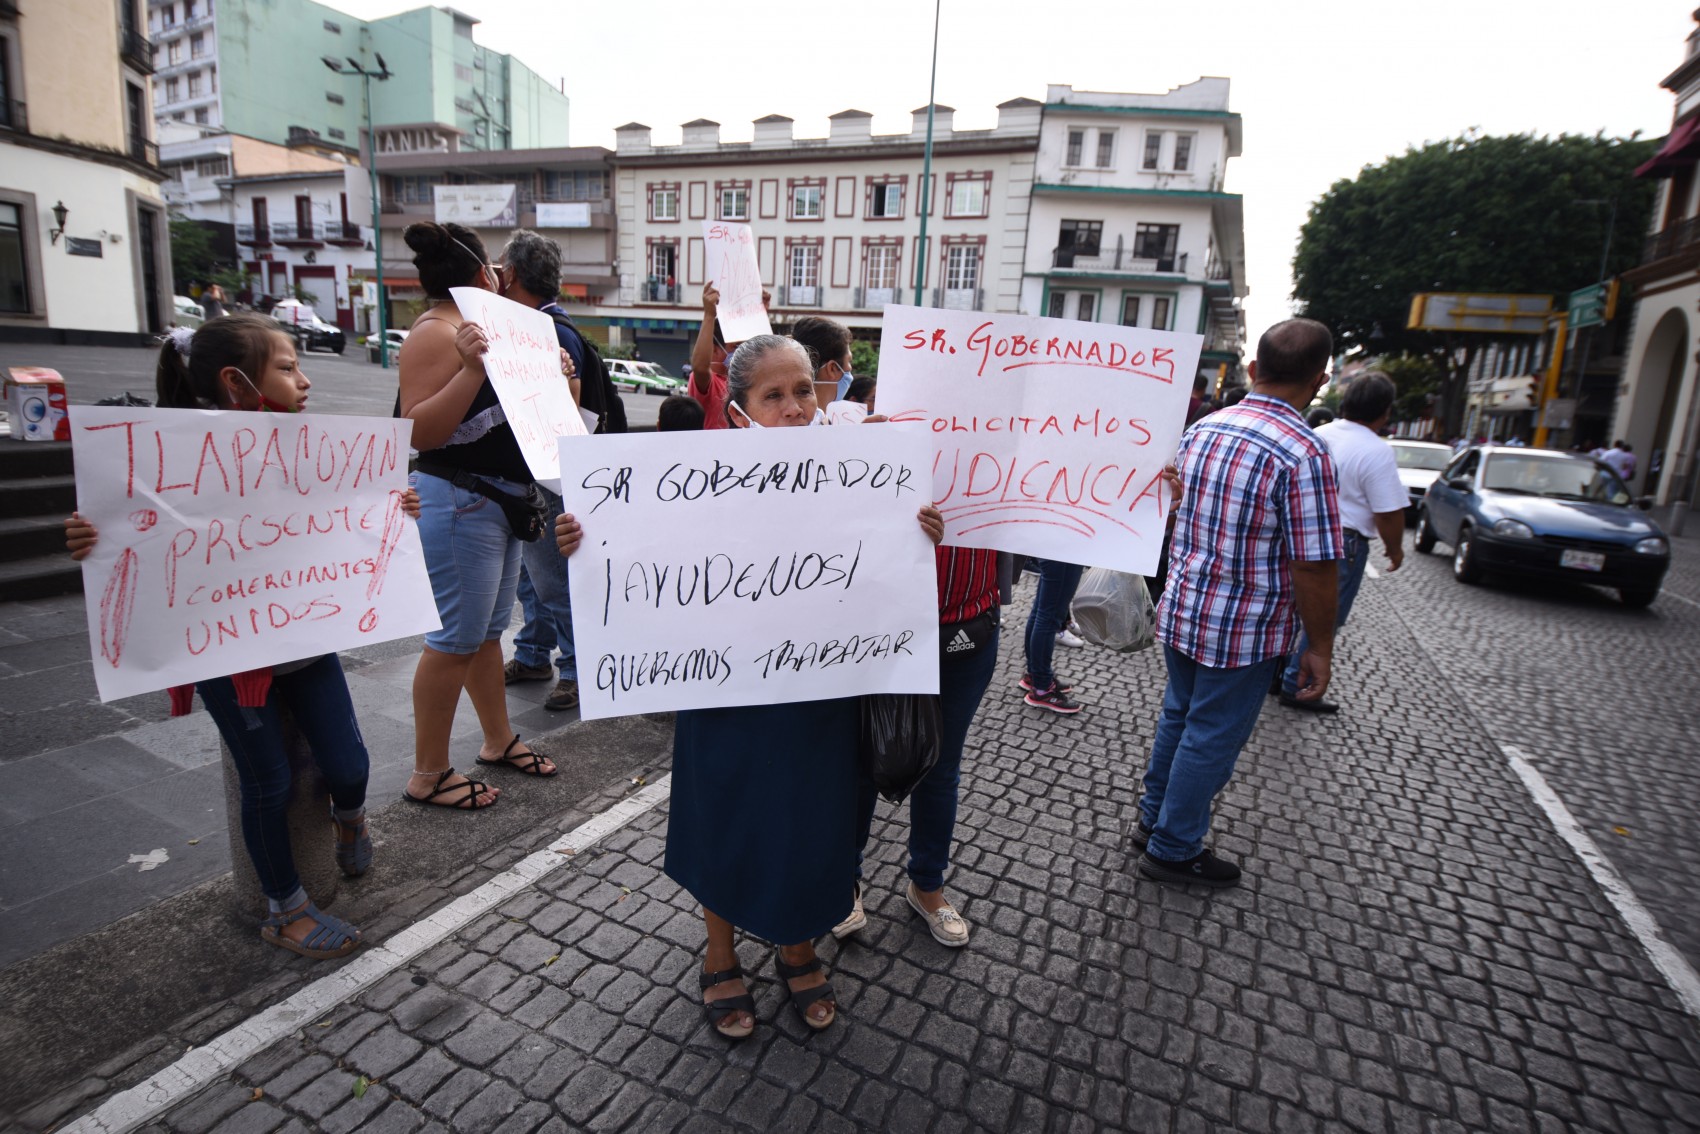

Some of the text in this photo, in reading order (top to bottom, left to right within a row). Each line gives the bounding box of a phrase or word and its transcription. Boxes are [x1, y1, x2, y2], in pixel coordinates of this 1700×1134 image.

[903, 328, 957, 355] SR.
[84, 420, 398, 498] TLAPACOYAN
[581, 458, 916, 515] SR GOBERNADOR
[186, 595, 341, 656] UNIDOS
[946, 641, 976, 653] adidas
[596, 630, 914, 701] QUEREMOS TRABAJAR
